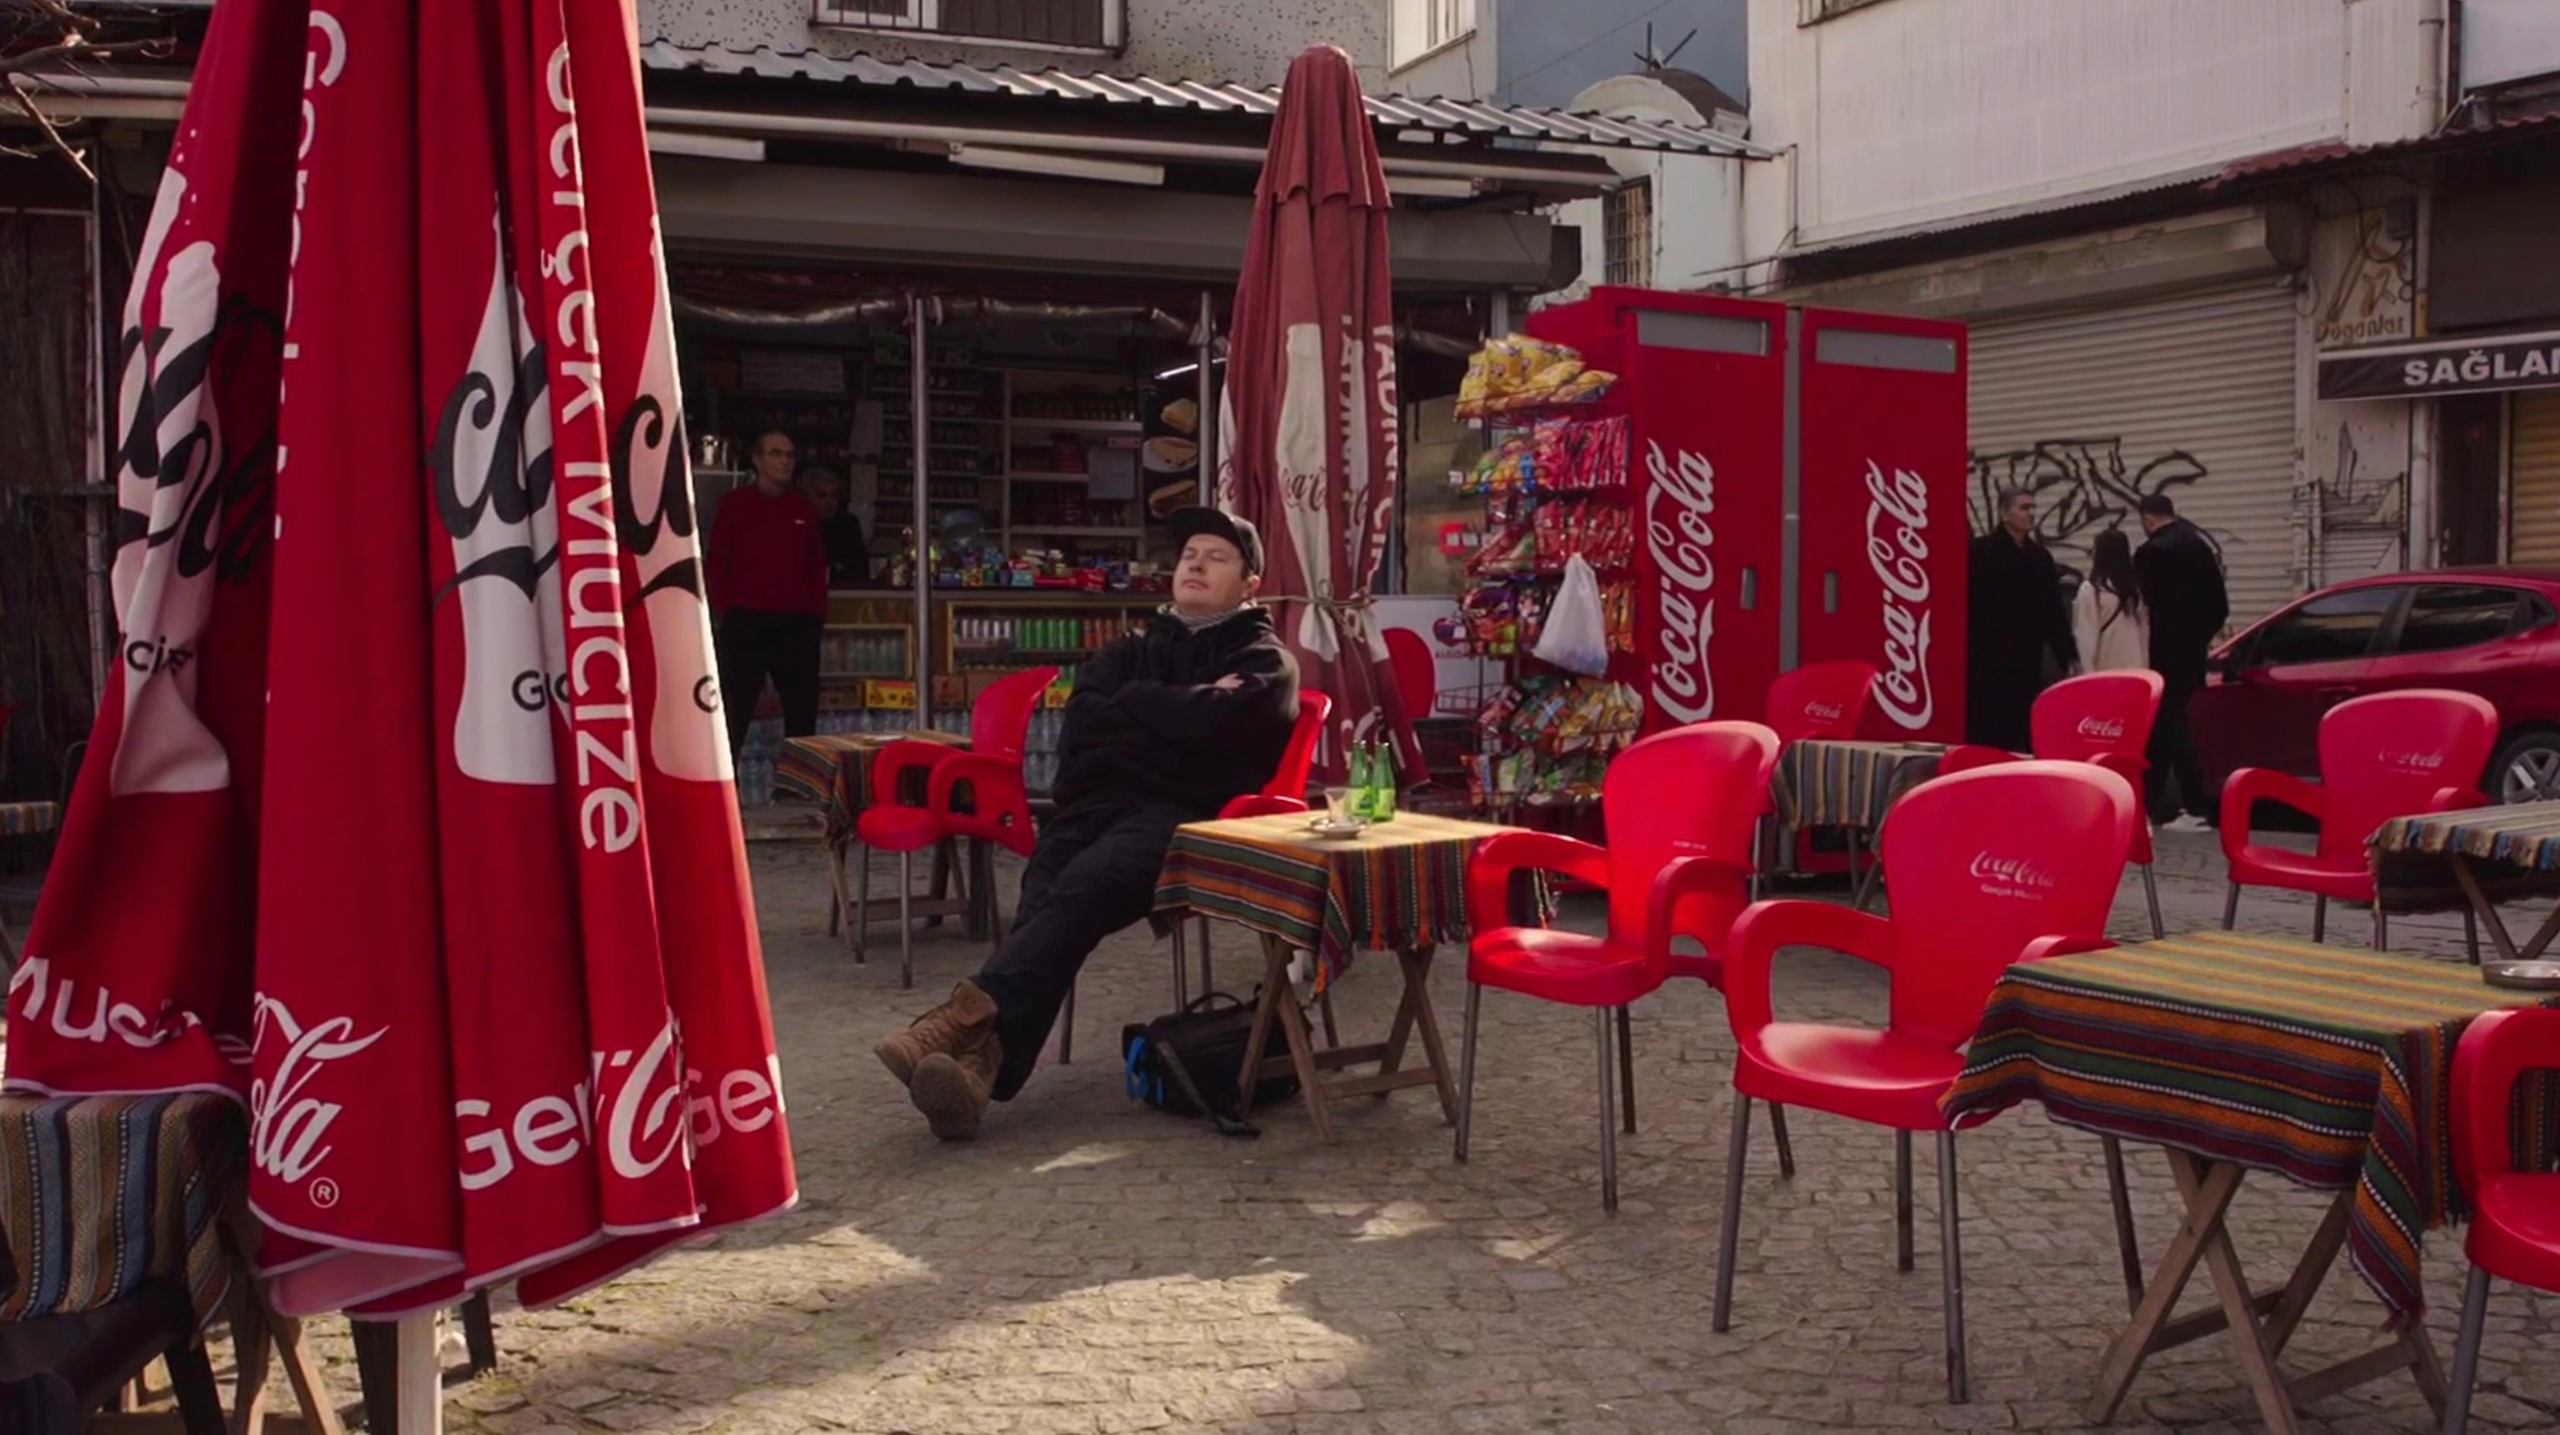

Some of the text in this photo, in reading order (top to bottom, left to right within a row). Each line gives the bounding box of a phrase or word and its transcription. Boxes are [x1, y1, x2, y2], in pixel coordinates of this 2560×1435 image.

[2404, 348, 2560, 386] SAĞLA
[1645, 437, 1714, 724] Coca-Cola
[1866, 457, 1932, 730] Coca-Cola
